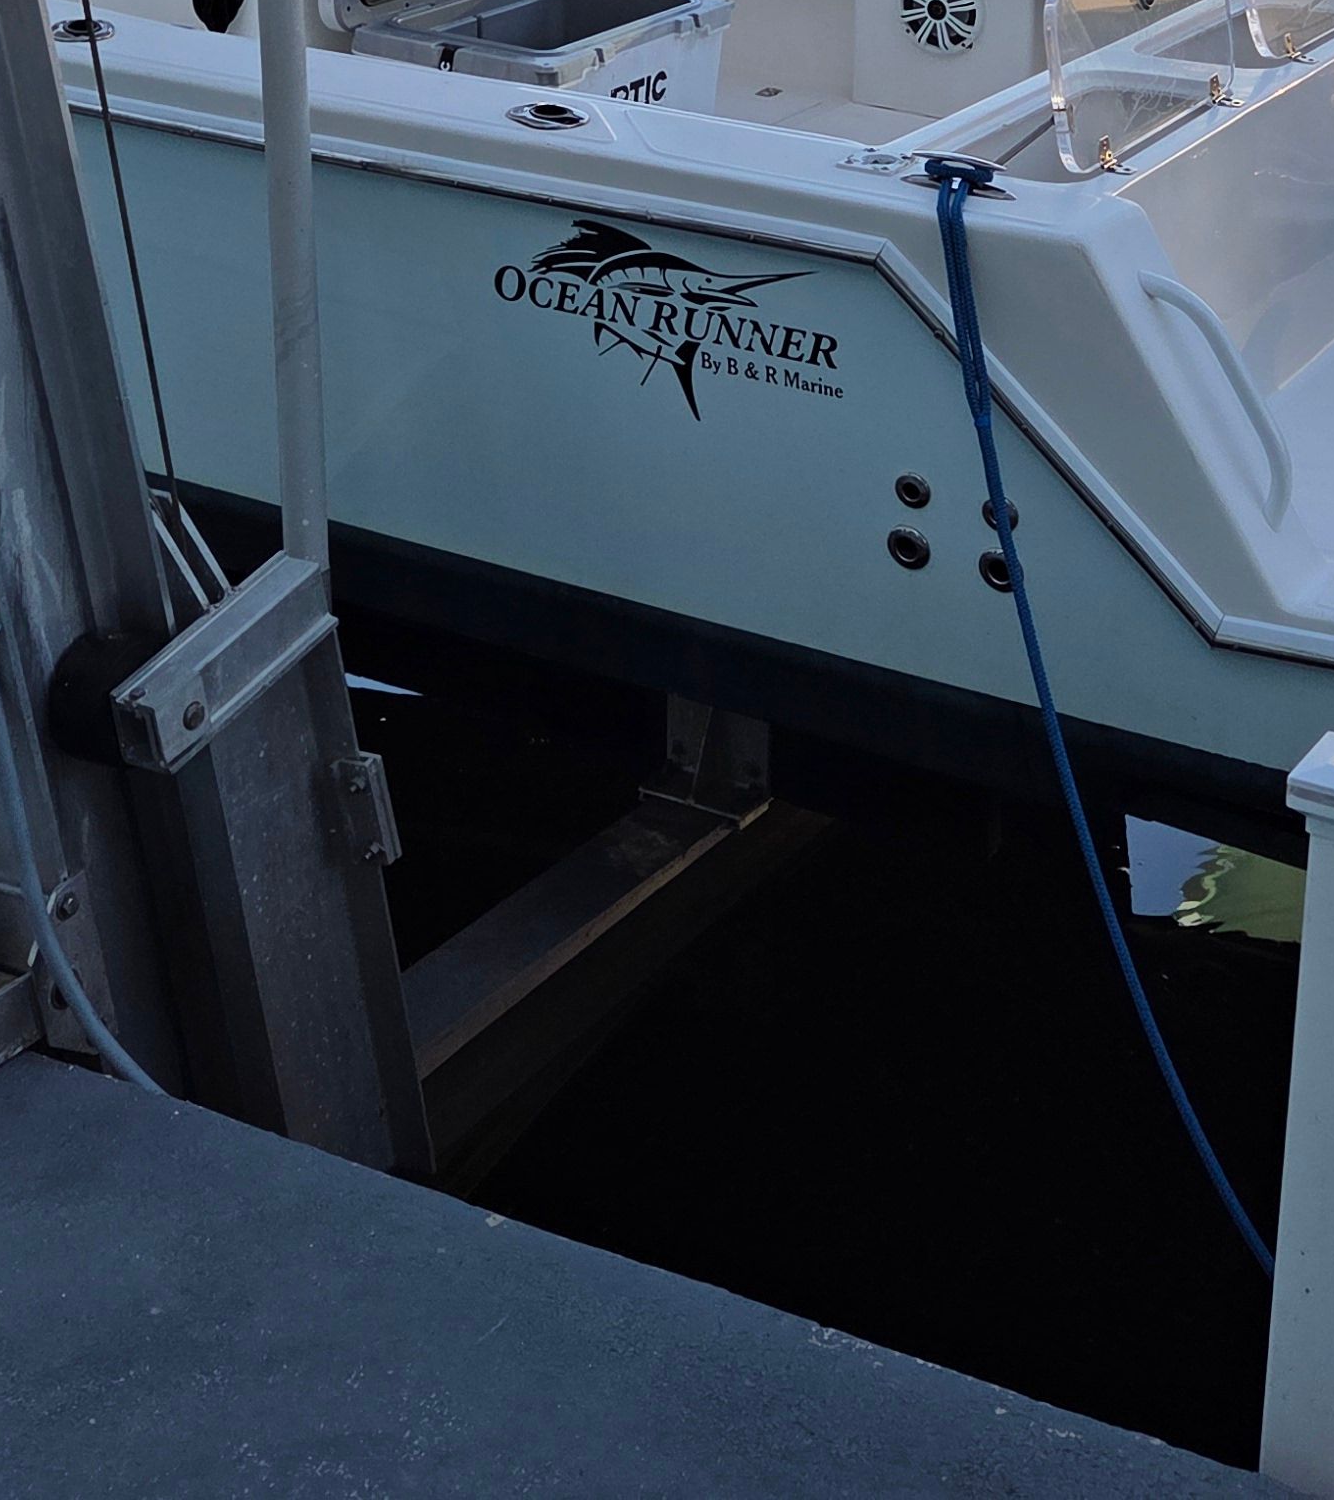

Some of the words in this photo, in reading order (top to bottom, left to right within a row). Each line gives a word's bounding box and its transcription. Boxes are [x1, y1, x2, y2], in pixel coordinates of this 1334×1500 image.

[494, 265, 641, 327] OCEAN
[648, 299, 838, 370] RUNNER
[701, 351, 722, 375] By
[727, 356, 739, 376] B
[744, 361, 760, 381] &
[765, 365, 779, 385] R
[784, 369, 844, 399] Marine
